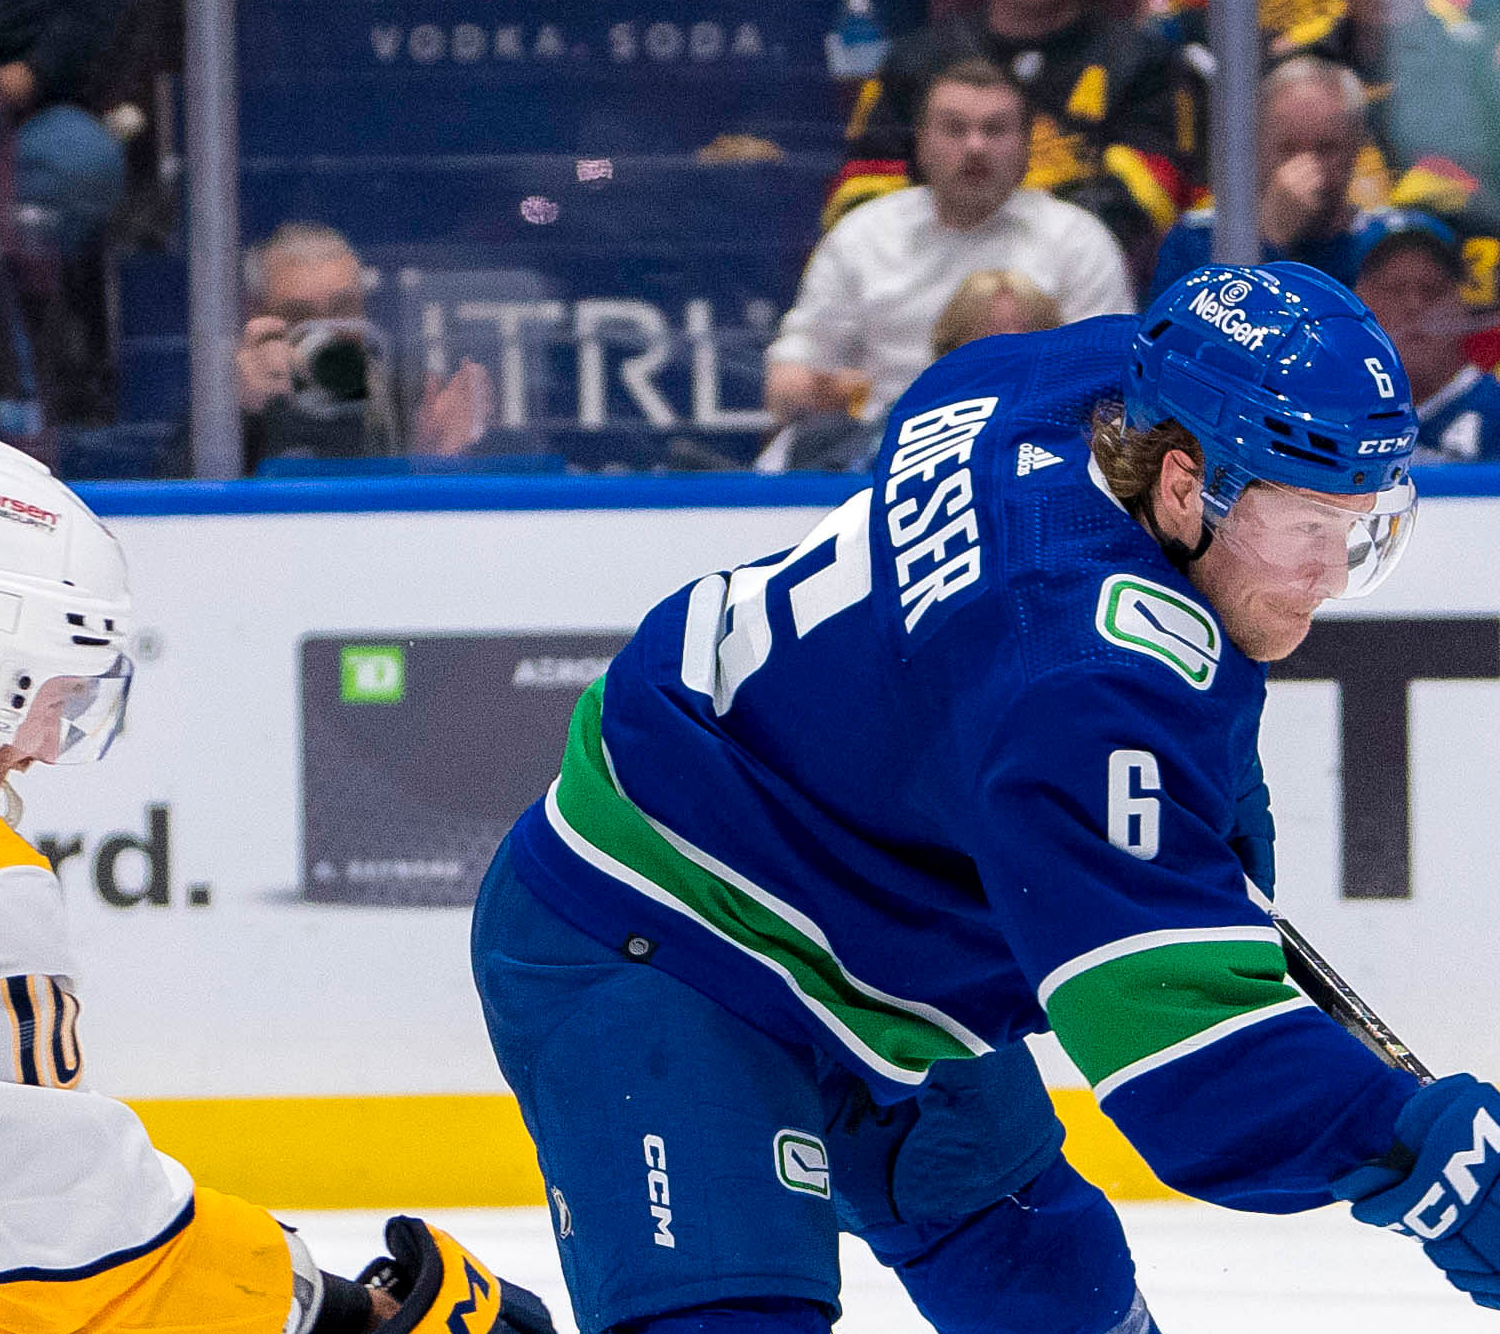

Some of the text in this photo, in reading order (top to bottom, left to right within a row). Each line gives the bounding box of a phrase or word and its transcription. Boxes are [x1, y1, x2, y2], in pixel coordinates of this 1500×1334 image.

[1187, 289, 1268, 353] NexGen
[1364, 357, 1395, 398] 6
[1016, 443, 1031, 477] adidas
[1357, 433, 1414, 455] CCM
[885, 396, 999, 634] BOESER
[1107, 749, 1161, 861] 6
[643, 1134, 676, 1250] CCM
